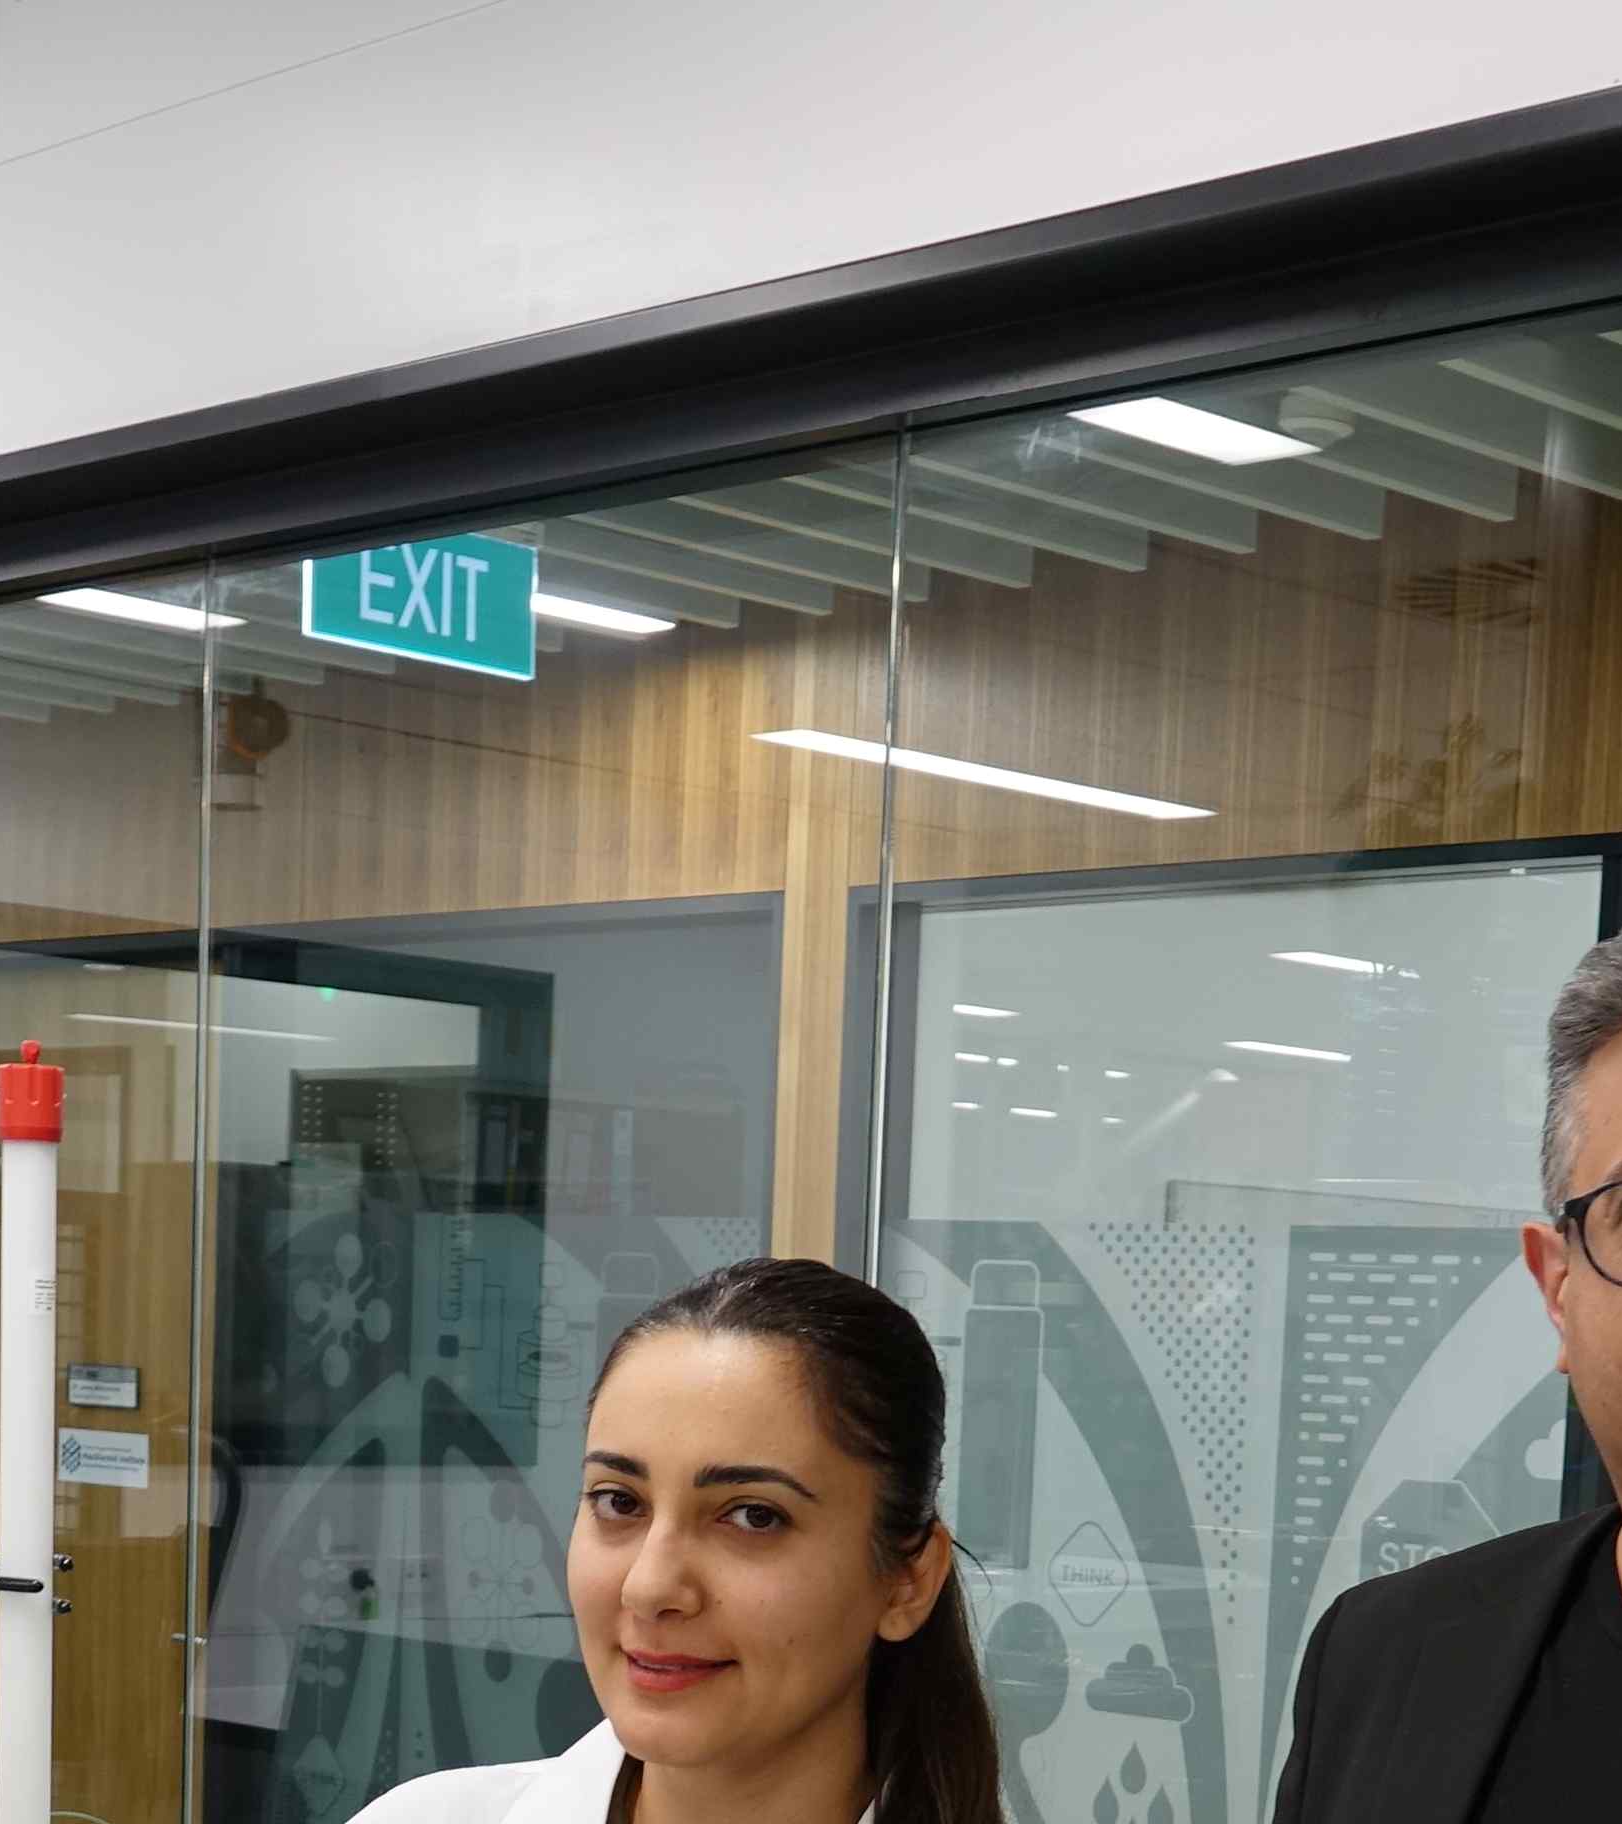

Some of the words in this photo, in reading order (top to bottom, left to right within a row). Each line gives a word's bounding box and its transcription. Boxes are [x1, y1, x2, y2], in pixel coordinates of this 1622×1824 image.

[359, 543, 489, 642] EXIT
[1377, 1541, 1447, 1575] ST
[1060, 1565, 1116, 1586] THINK
